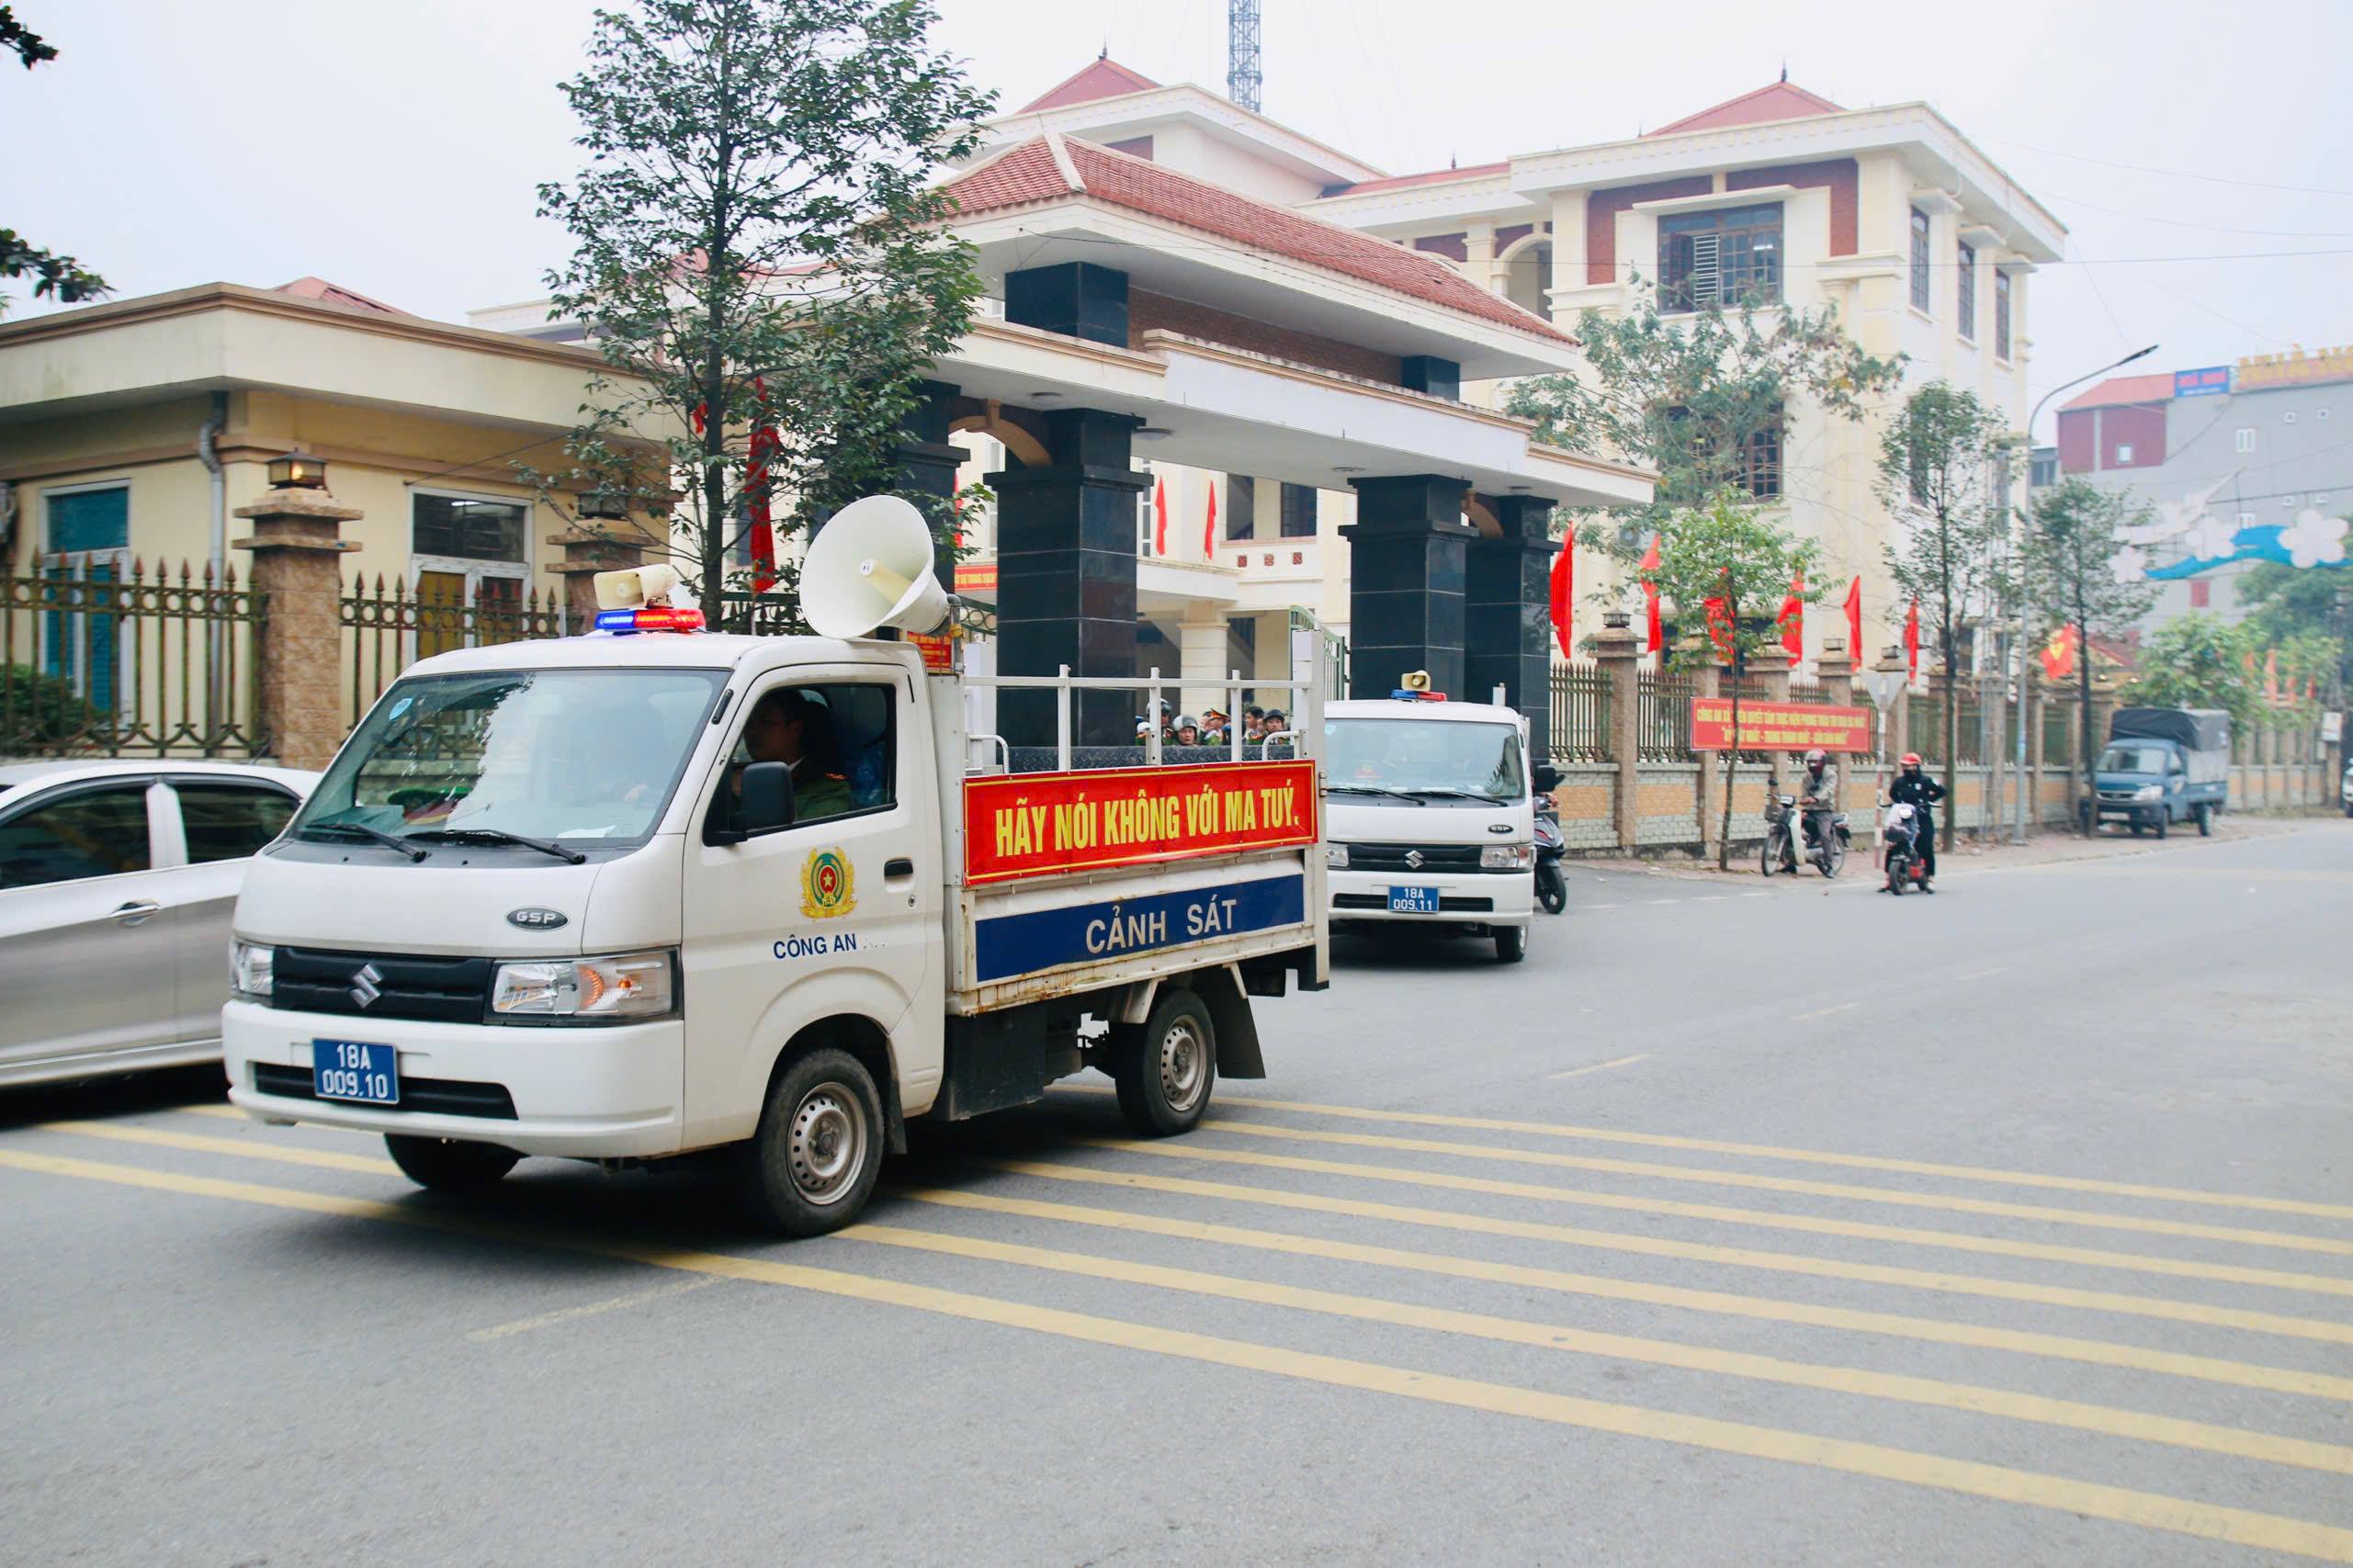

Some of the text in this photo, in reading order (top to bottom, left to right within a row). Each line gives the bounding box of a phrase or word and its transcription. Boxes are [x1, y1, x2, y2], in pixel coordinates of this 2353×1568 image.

[995, 797, 1046, 857] HÃY
[1055, 792, 1097, 851] NÓI
[1104, 788, 1181, 846] KHÔNG
[1185, 784, 1218, 837] VỚI
[1225, 790, 1256, 832] MA
[1393, 898, 1432, 911] 009.11
[1404, 887, 1425, 899] 18A
[515, 911, 557, 924] GSP
[1085, 894, 1237, 954] CẢNH SÁT
[774, 933, 857, 959] CÔNG AN
[336, 1043, 372, 1070] 18A
[322, 1068, 389, 1099] 009.10
